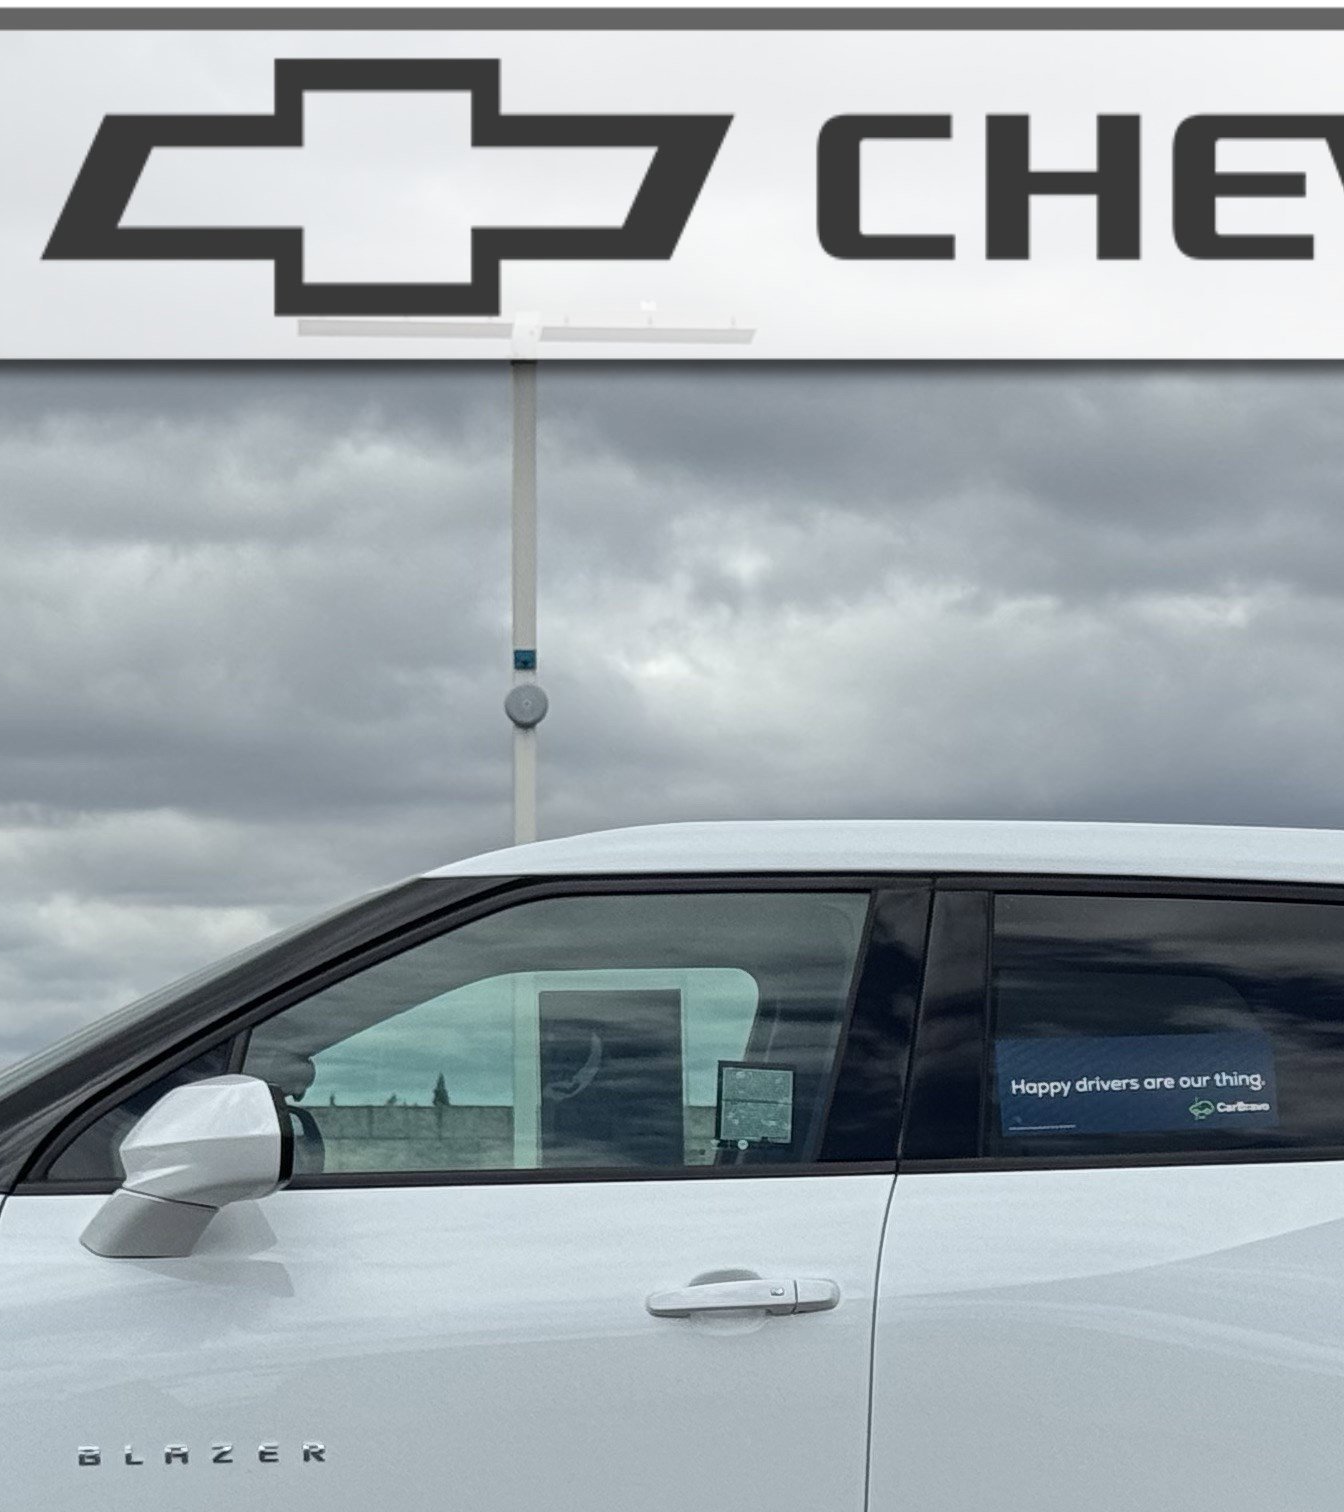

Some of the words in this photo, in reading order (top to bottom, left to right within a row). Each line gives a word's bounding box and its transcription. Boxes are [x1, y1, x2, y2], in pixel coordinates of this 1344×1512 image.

[1010, 1078, 1072, 1098] Happy
[1075, 1075, 1141, 1094] drivers
[1143, 1076, 1176, 1091] are
[1178, 1074, 1210, 1089] our
[1212, 1071, 1267, 1091] thing.
[77, 1441, 326, 1467] BLAZER
